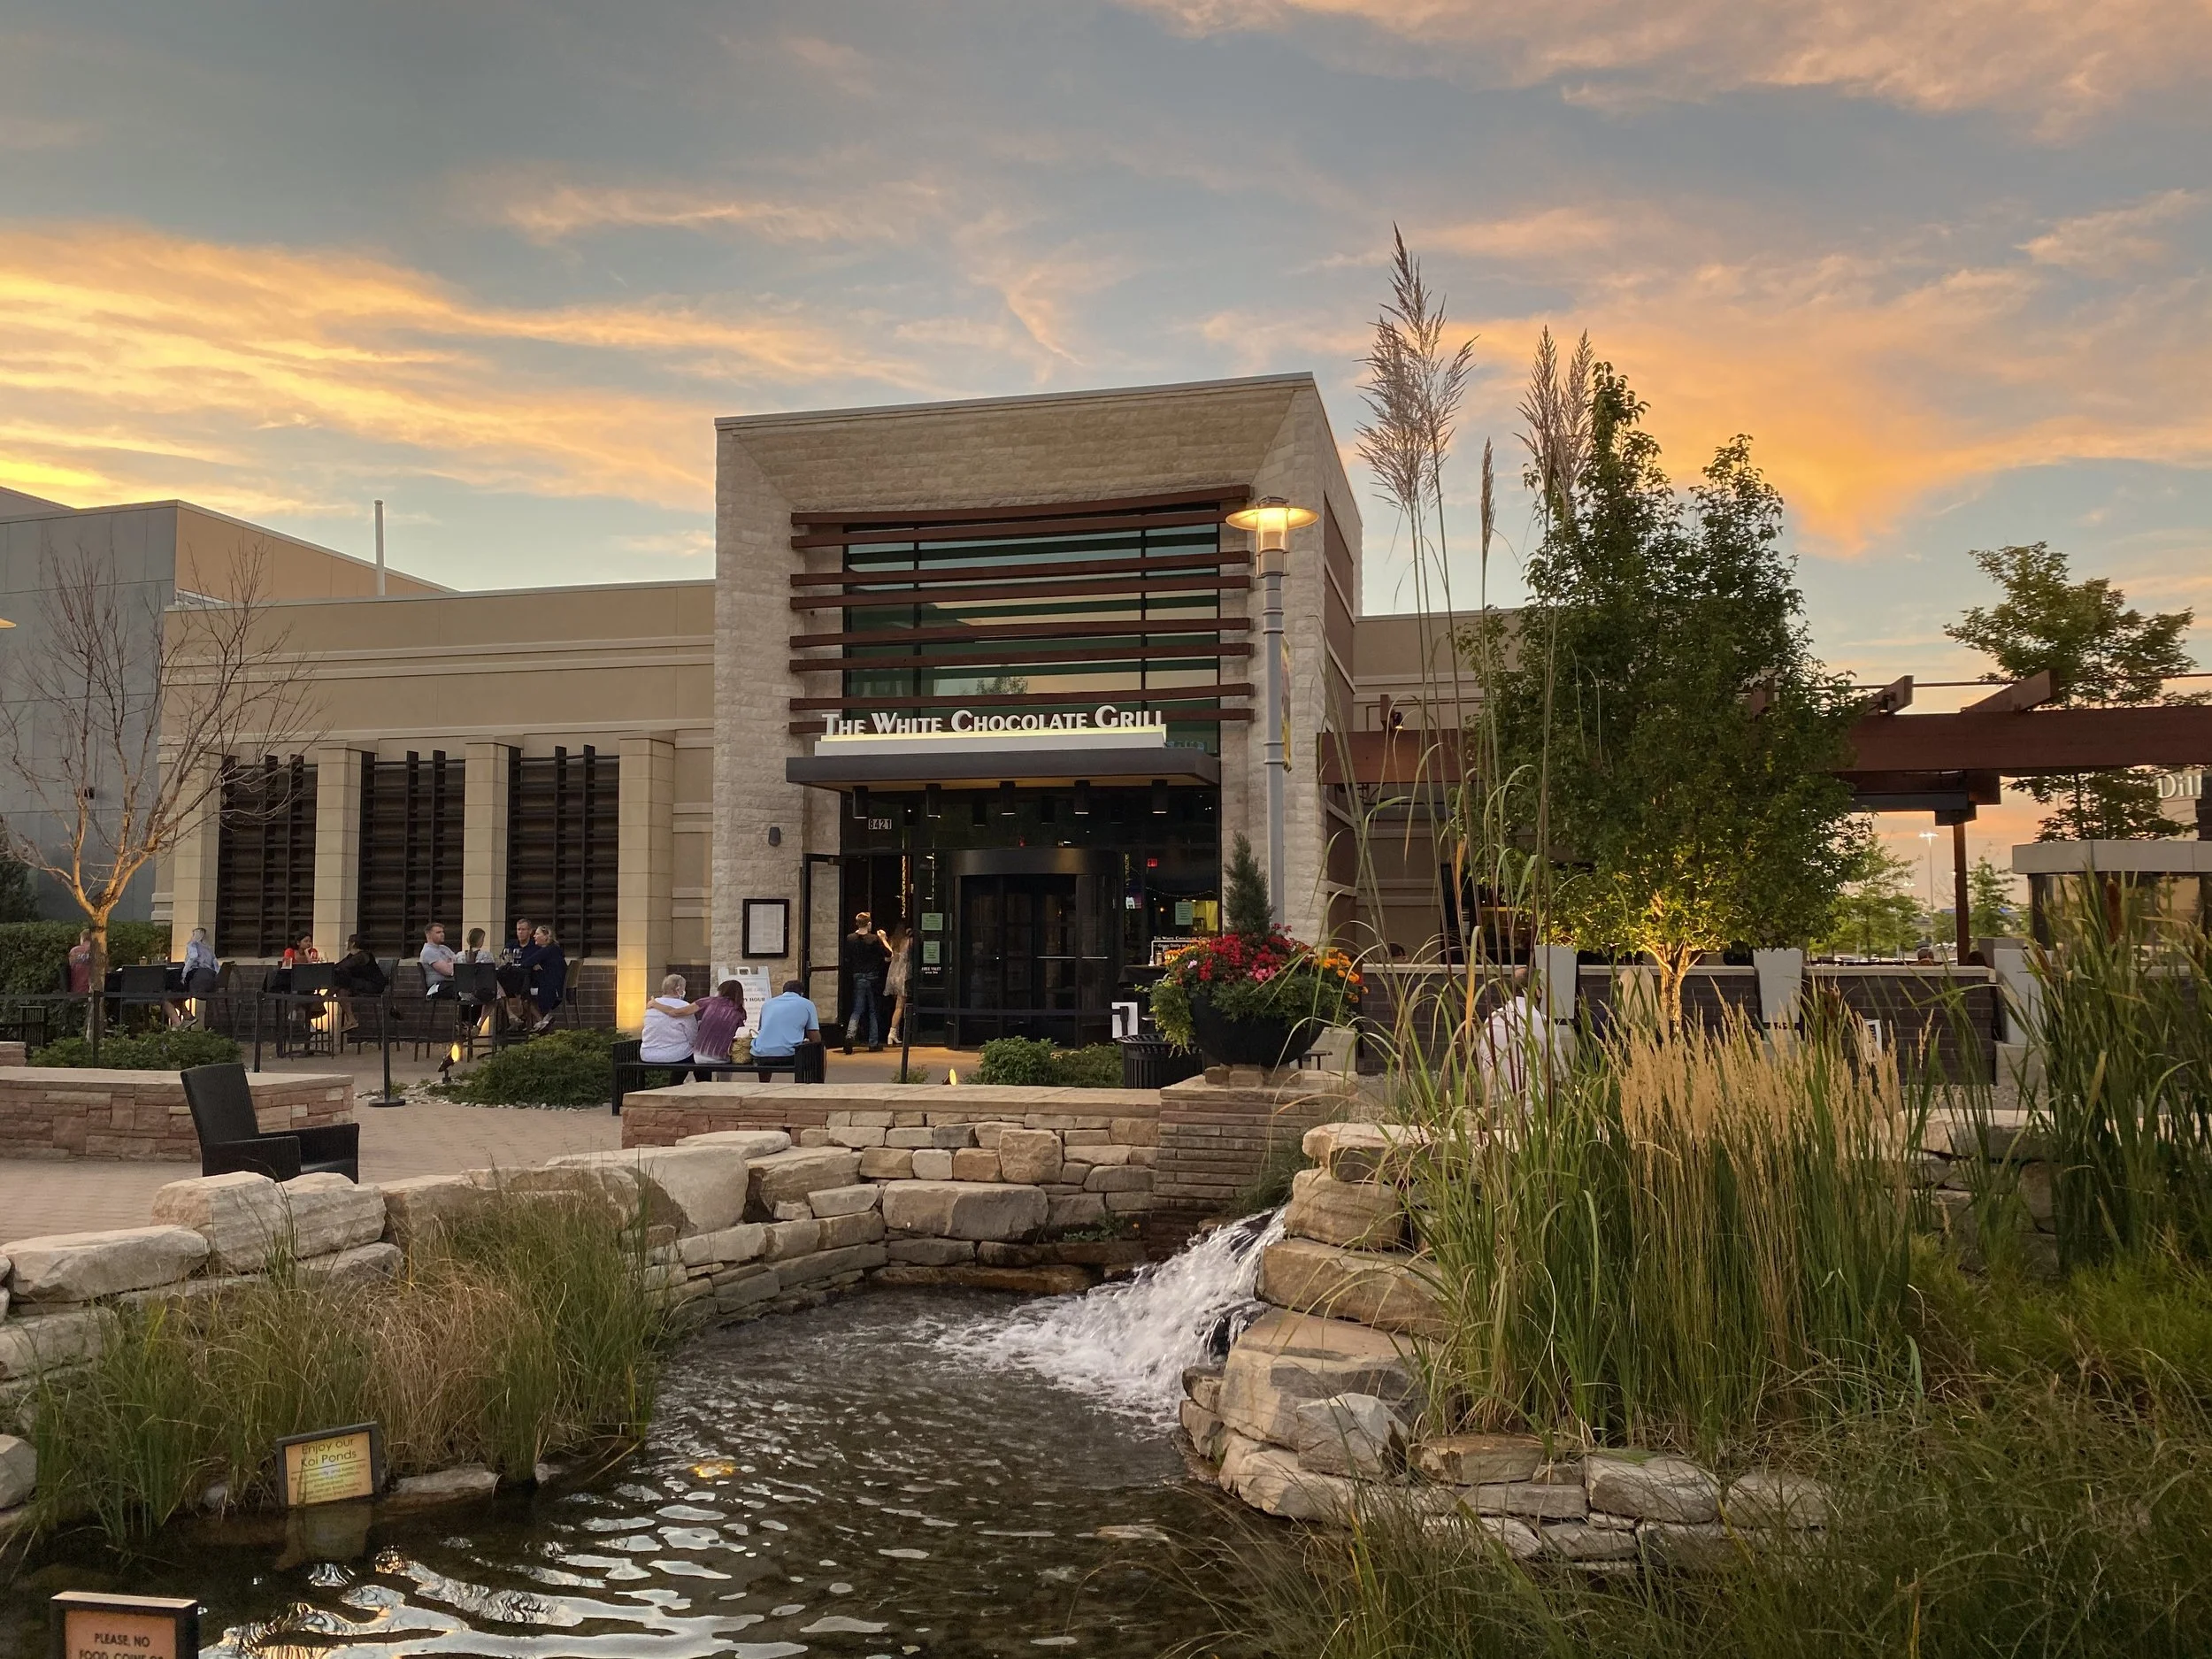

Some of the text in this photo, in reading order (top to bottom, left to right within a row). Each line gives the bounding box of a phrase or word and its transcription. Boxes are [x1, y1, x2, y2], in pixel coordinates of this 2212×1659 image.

[821, 705, 1165, 736] THE WHITE CHOCOLATE GRILL
[870, 819, 890, 829] 8421
[302, 1439, 354, 1454] Enjoy our
[301, 1450, 357, 1467] Koi Ponds
[134, 1635, 150, 1647] NO
